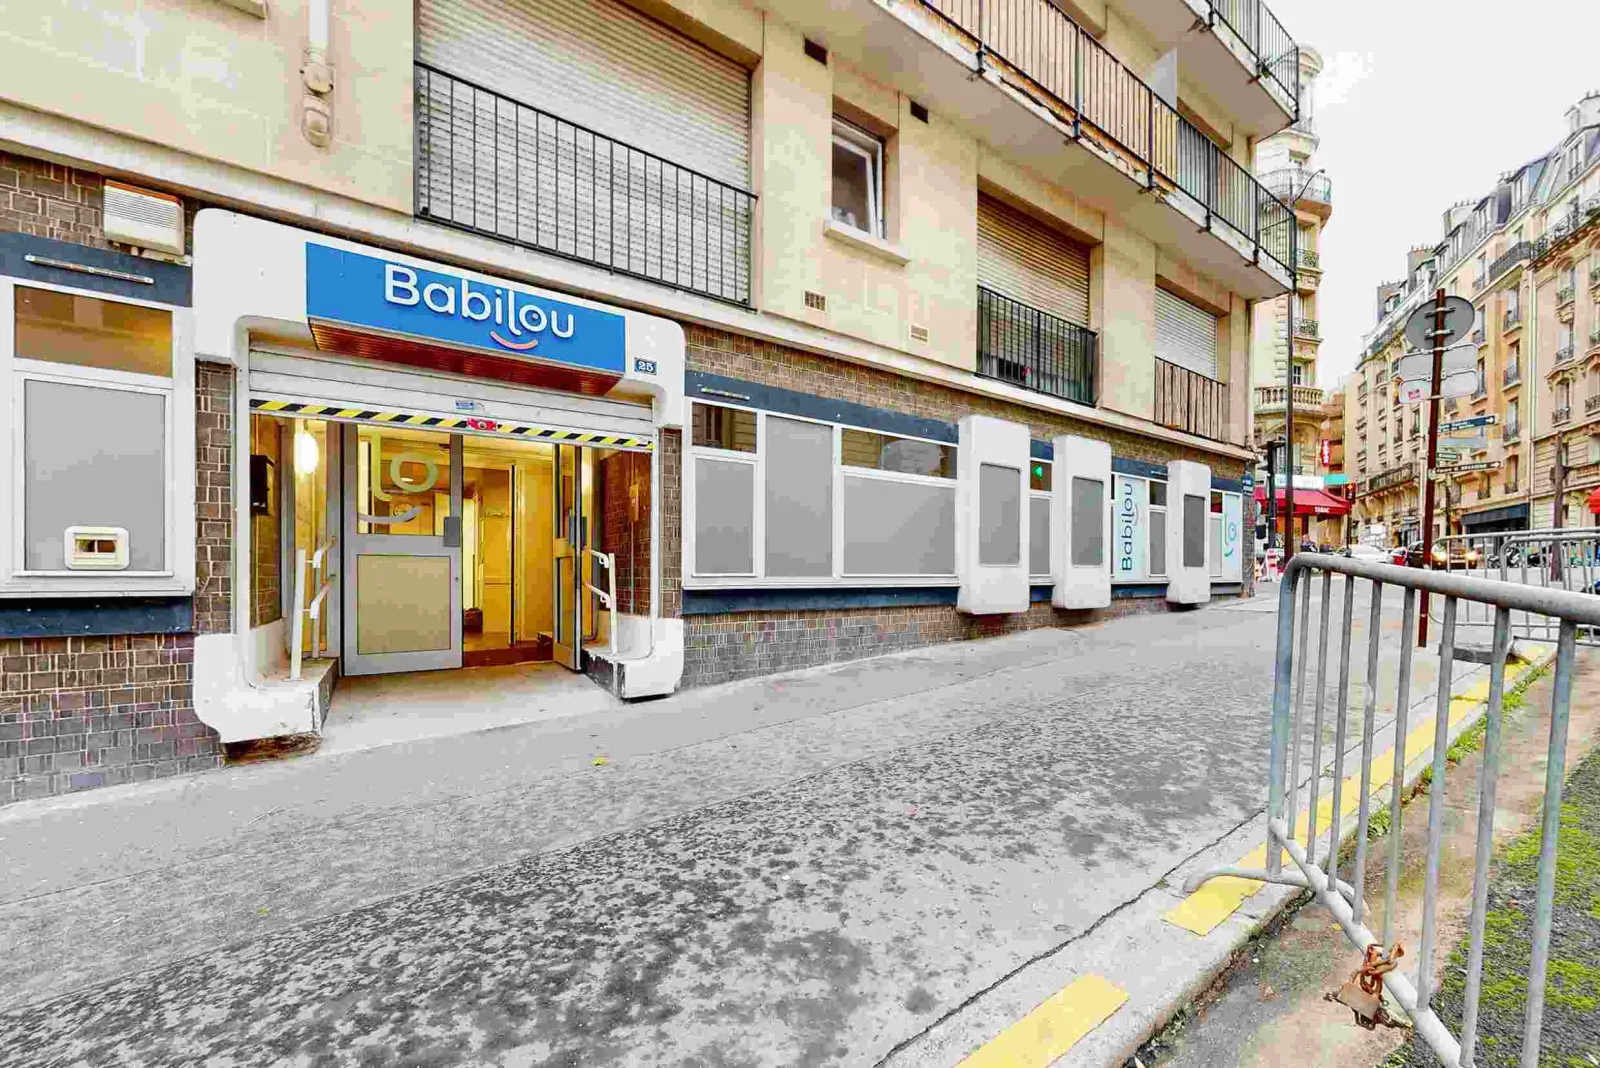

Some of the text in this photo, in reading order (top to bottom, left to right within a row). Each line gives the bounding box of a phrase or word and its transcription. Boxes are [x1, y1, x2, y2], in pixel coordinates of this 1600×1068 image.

[384, 263, 575, 339] Babilou
[638, 360, 654, 372] 25
[1121, 483, 1135, 571] Babilou
